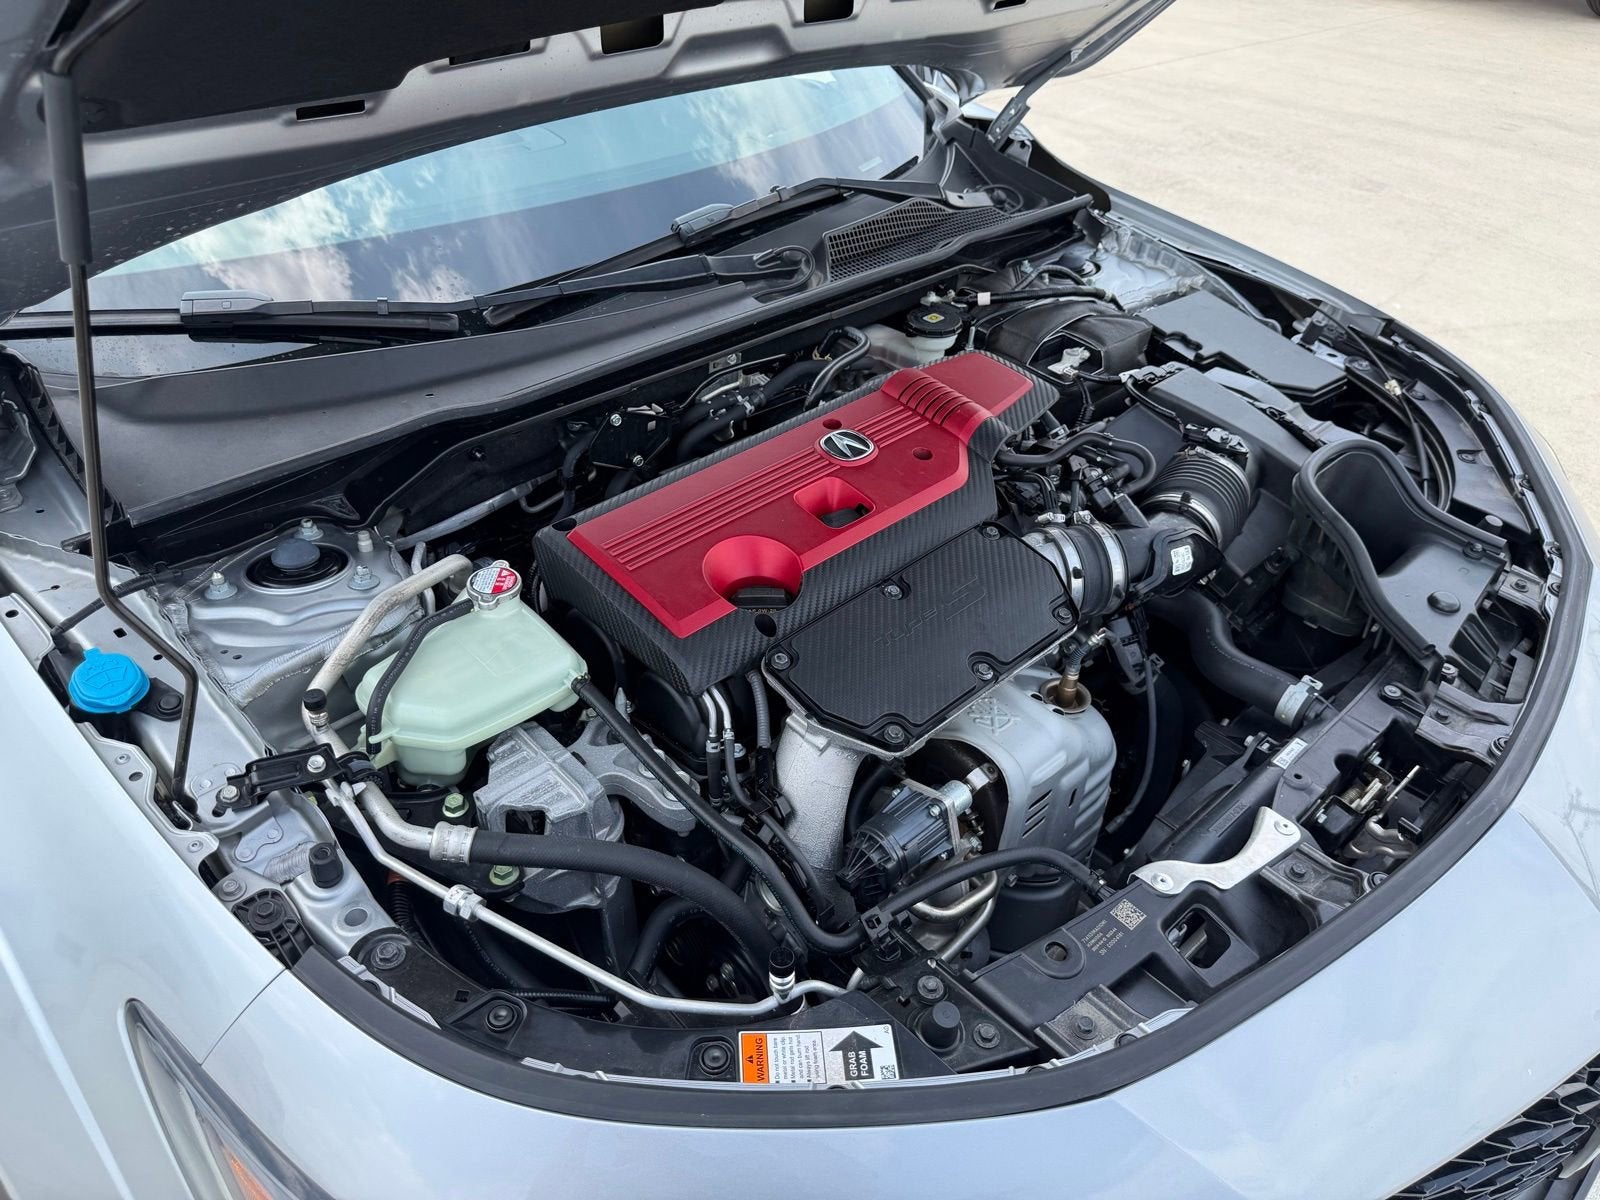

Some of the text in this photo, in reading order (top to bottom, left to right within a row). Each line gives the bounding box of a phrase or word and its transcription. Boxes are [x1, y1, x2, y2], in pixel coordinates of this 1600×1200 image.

[755, 1037, 765, 1081] WARNING
[848, 1051, 858, 1077] GRAB
[858, 1050, 869, 1077] FOAM
